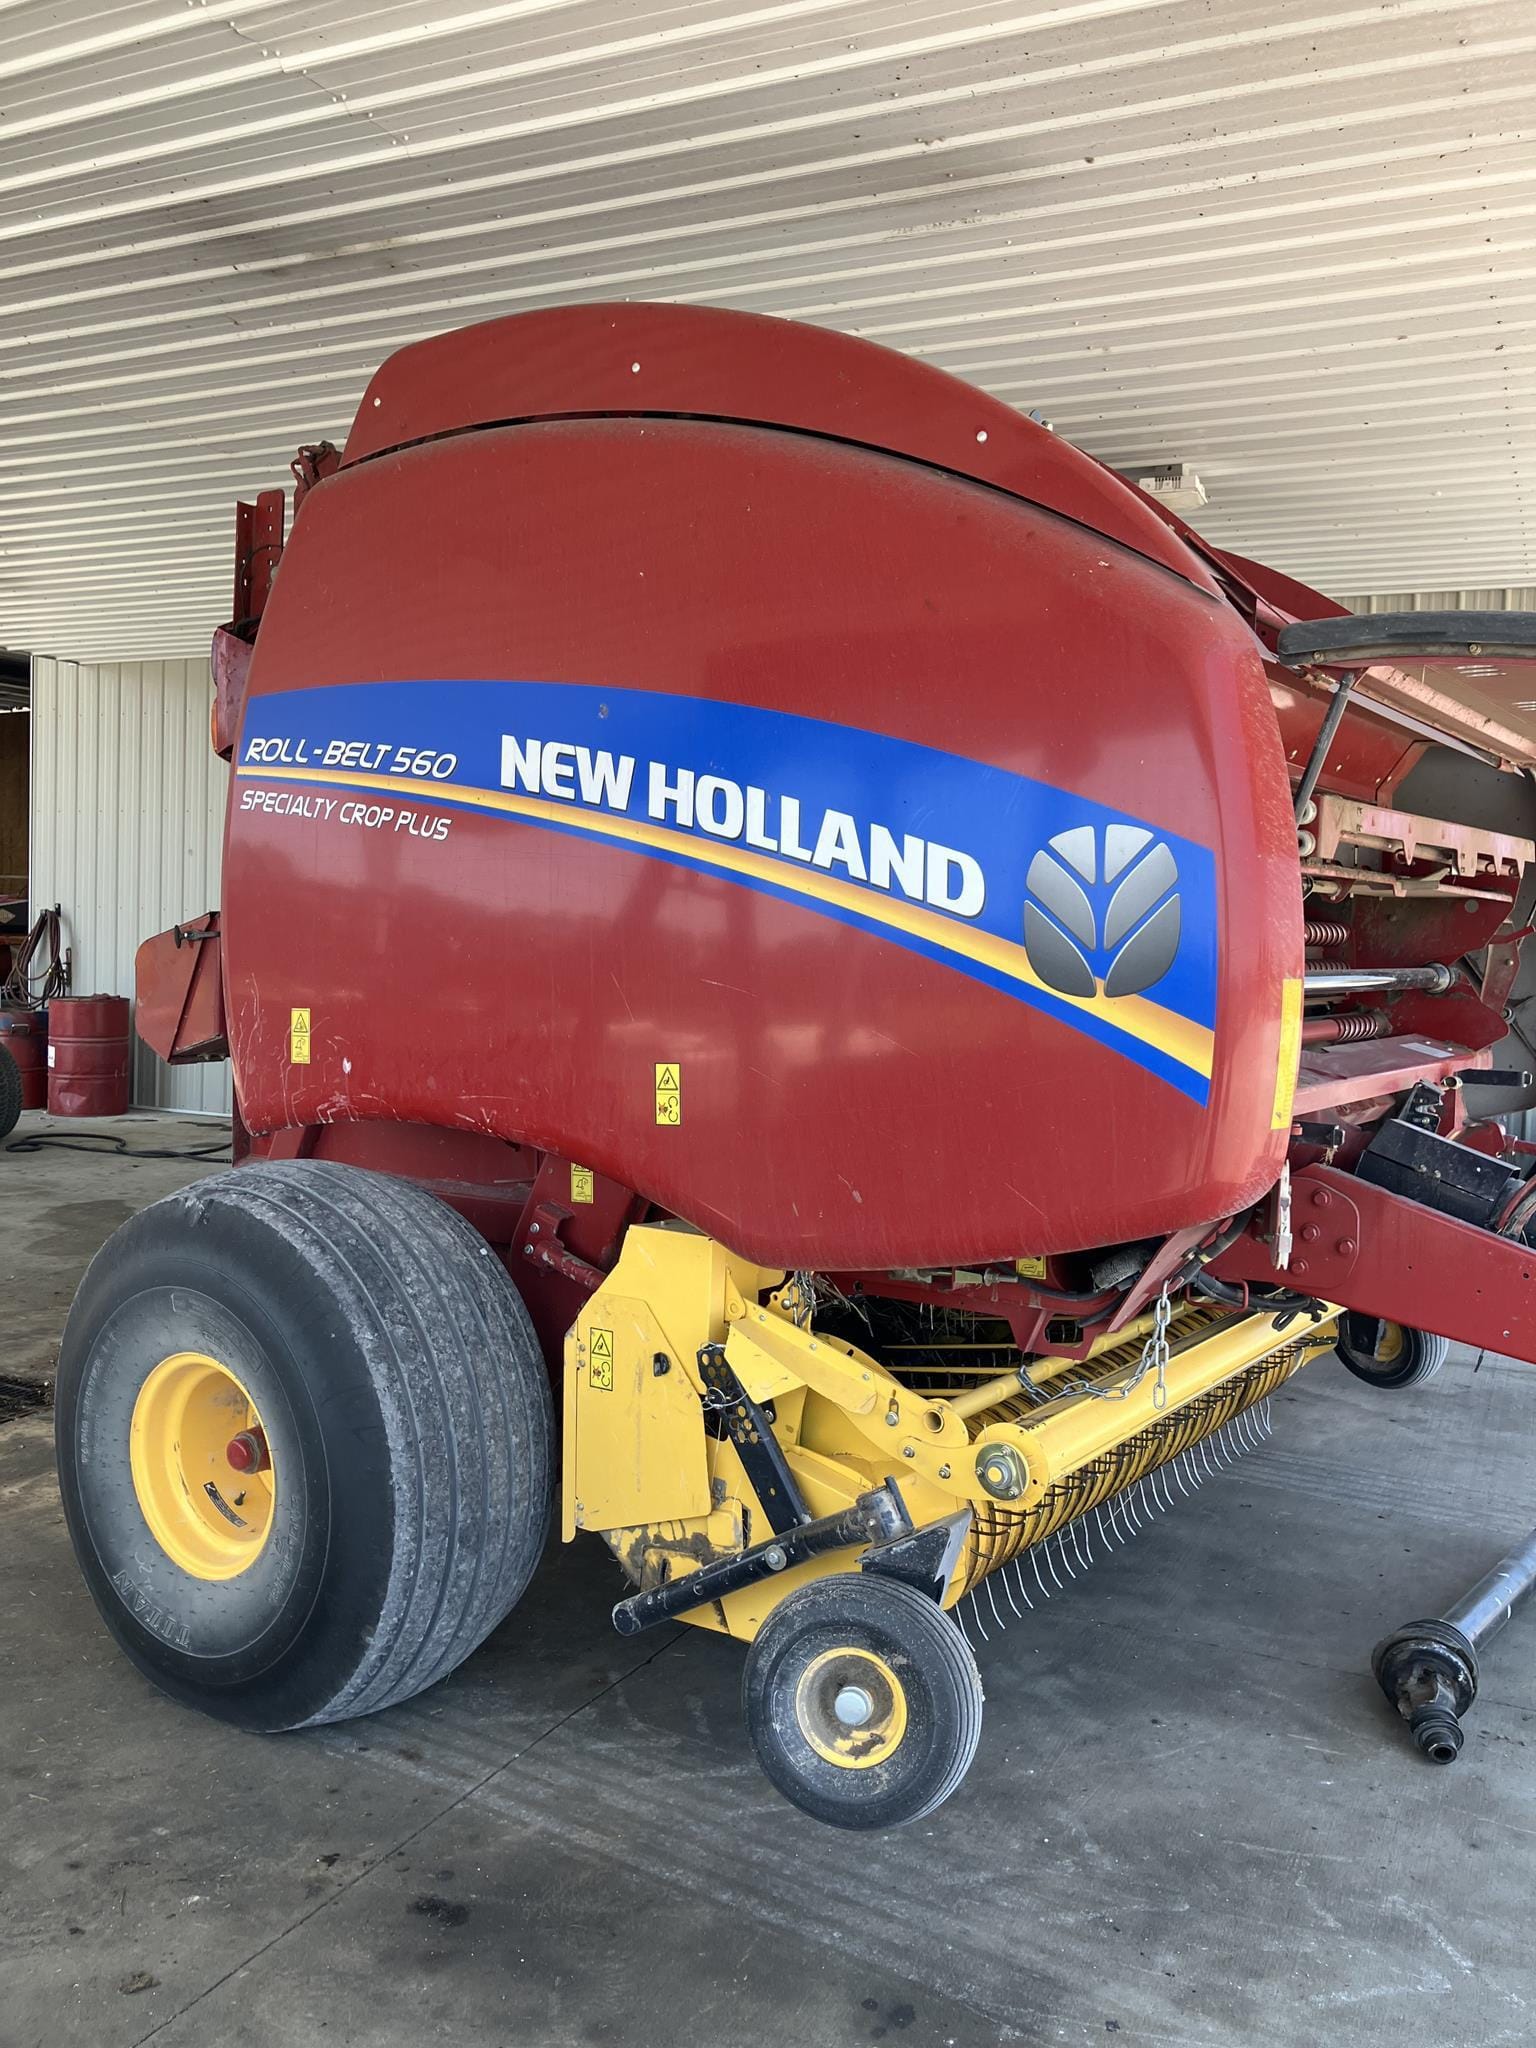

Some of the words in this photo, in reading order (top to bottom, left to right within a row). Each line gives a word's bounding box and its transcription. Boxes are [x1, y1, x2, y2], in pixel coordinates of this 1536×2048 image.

[390, 747, 457, 779] 560
[240, 790, 338, 820] SPECIALTY
[339, 802, 394, 829] CROP
[395, 810, 452, 841] PLUS
[501, 734, 636, 811] NEW
[648, 761, 985, 918] HOLLAND
[112, 1569, 191, 1649] TITAN
